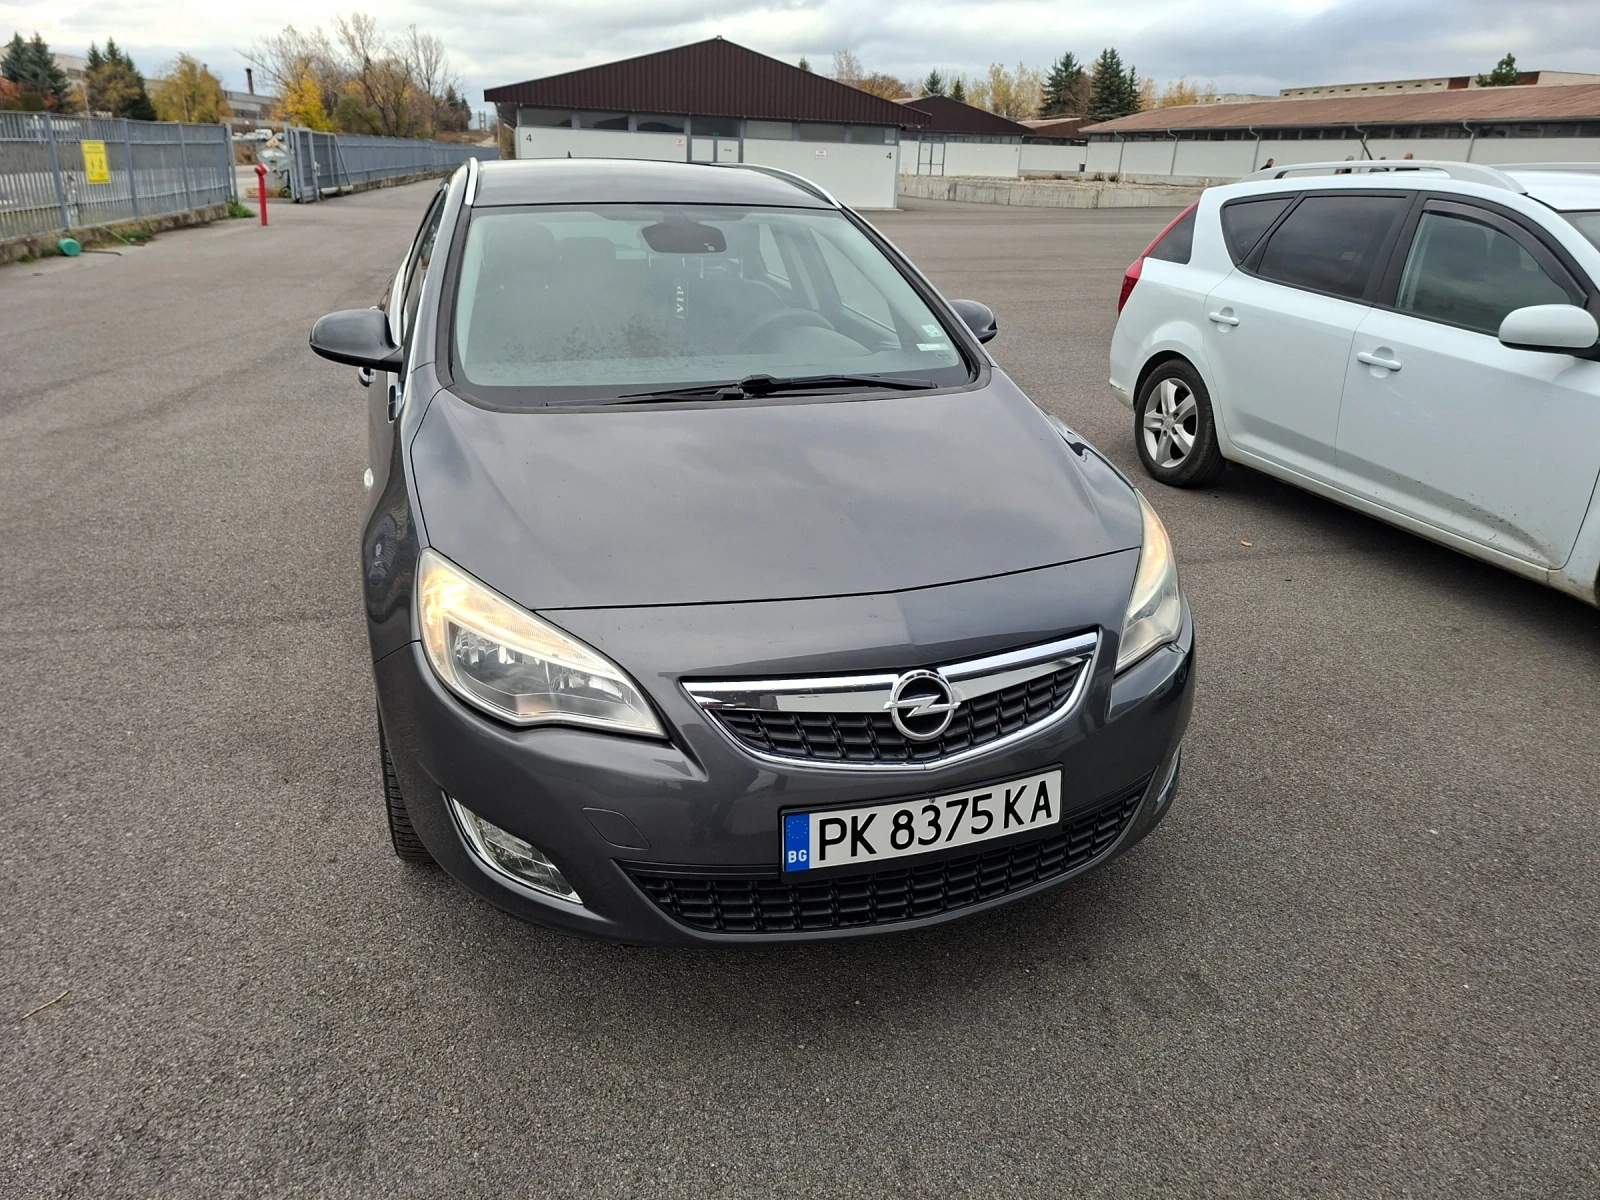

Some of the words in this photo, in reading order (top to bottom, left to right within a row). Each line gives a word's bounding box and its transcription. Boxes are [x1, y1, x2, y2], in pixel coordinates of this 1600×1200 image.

[525, 134, 532, 143] 4
[886, 152, 892, 160] 4
[676, 285, 684, 313] VIP
[818, 813, 878, 861] PK
[890, 792, 994, 851] 8375
[1003, 780, 1053, 829] KA
[788, 849, 807, 863] BG
